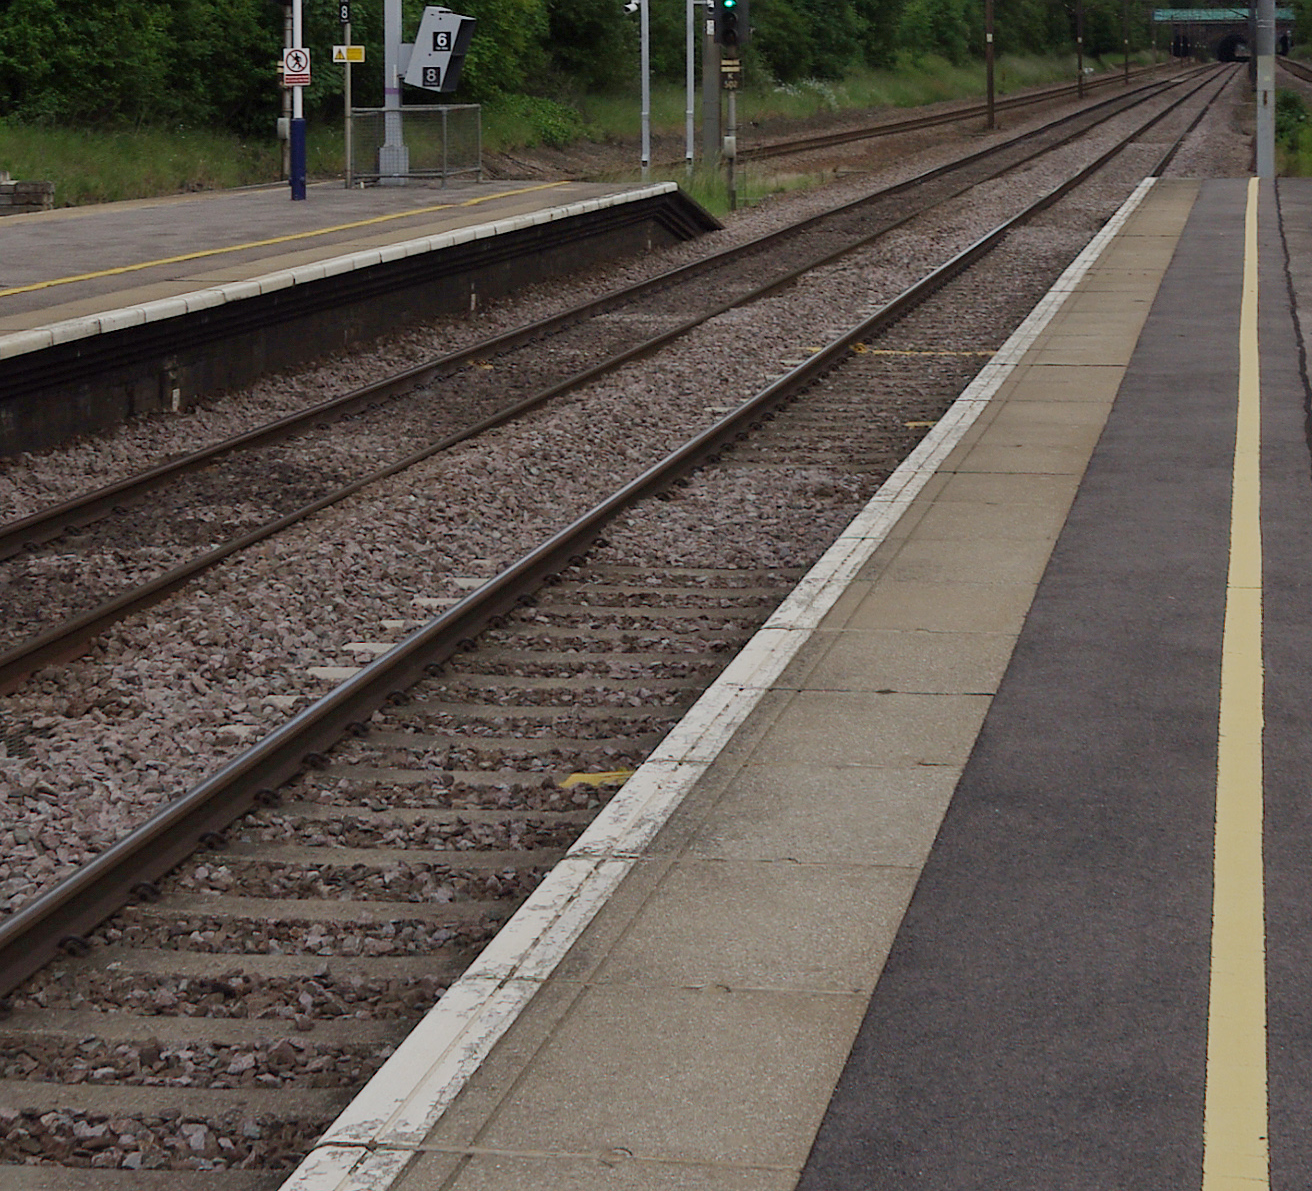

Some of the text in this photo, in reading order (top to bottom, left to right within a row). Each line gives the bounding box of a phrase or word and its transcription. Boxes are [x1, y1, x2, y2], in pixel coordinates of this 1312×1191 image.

[340, 5, 348, 19] 8
[436, 33, 448, 47] 6
[426, 68, 437, 83] 8
